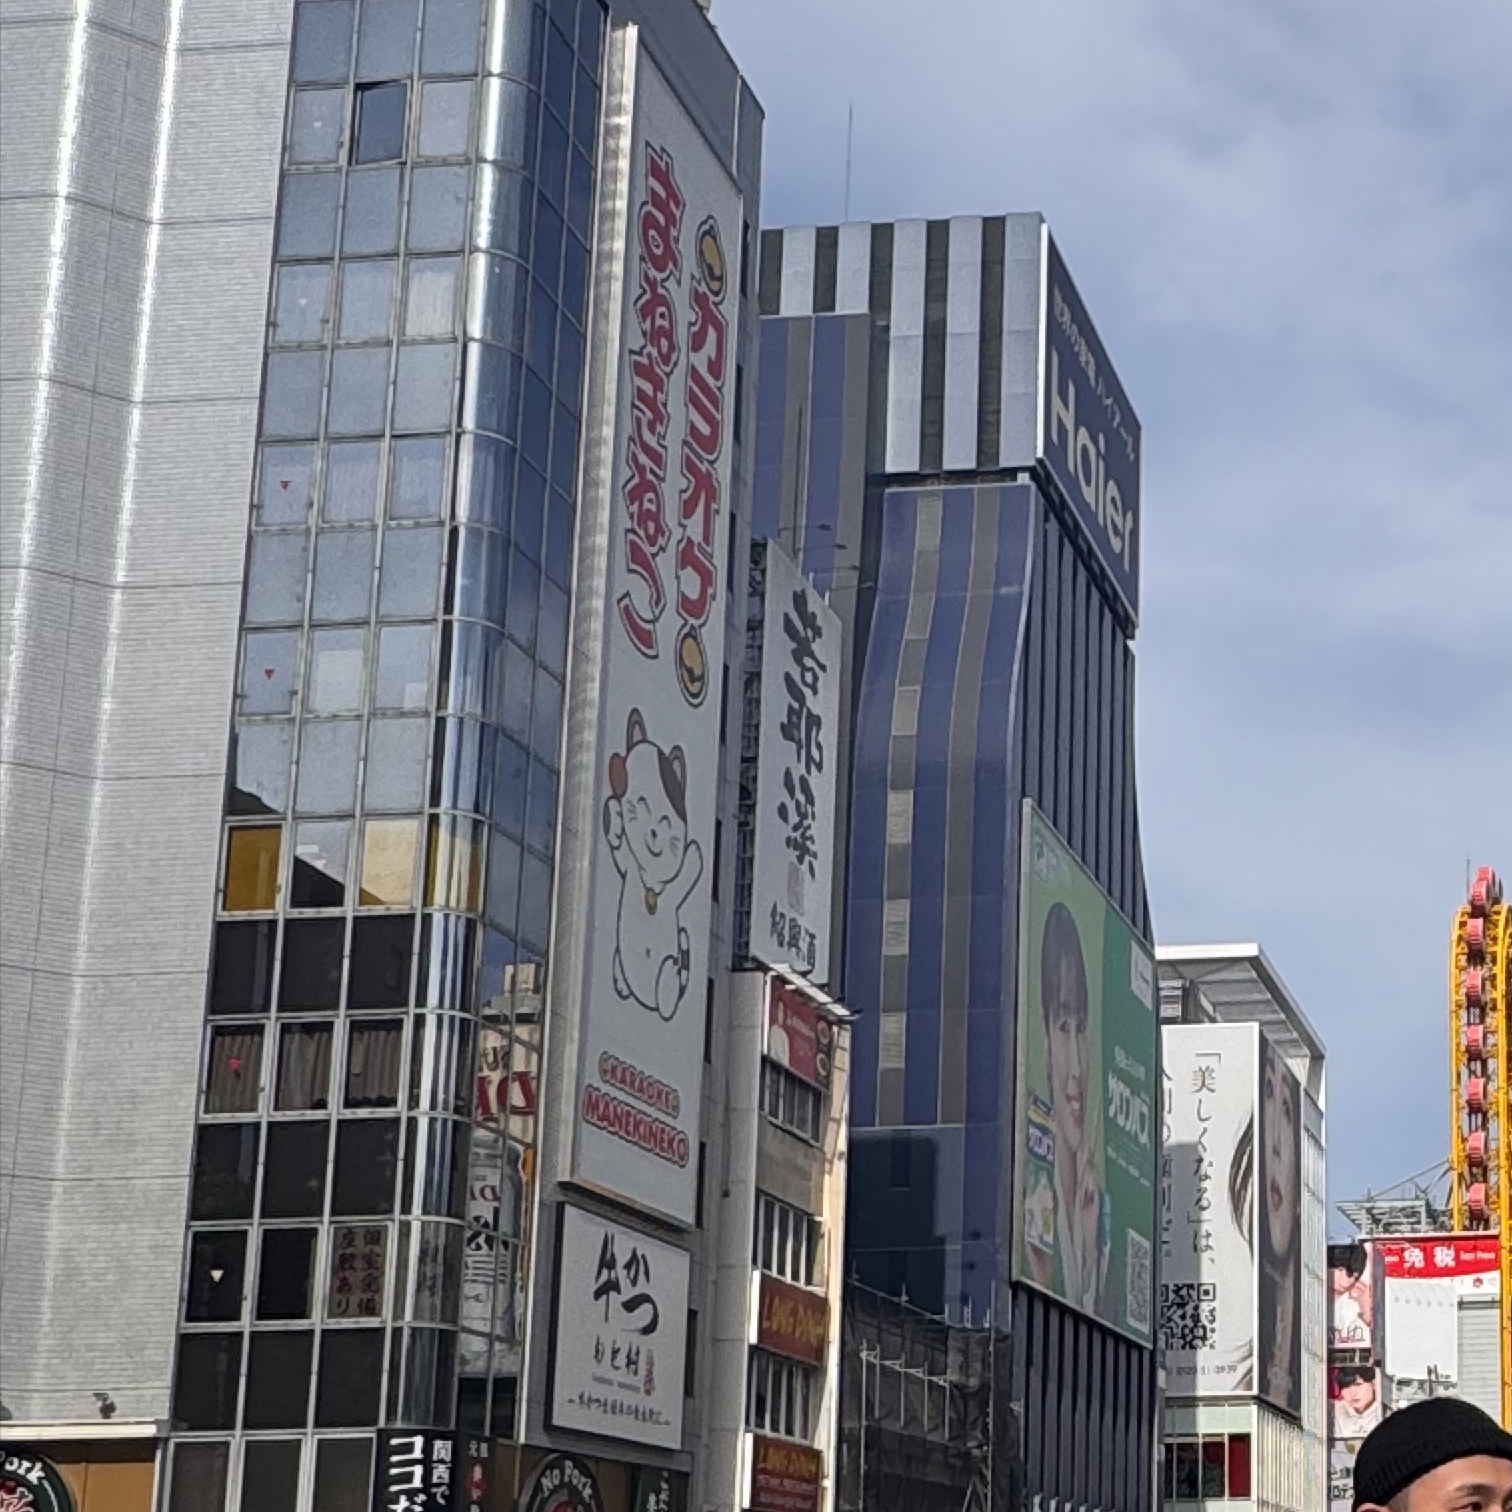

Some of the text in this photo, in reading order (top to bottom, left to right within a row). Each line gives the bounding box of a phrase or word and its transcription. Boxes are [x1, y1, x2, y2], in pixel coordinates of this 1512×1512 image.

[617, 139, 686, 660] まねきねこ
[677, 272, 728, 628] カラオケ
[1051, 347, 1134, 574] Haier
[607, 1058, 672, 1113] KARAOKE
[583, 1087, 688, 1167] MANEKINEKO
[593, 1230, 660, 1335] 牛かつ
[1402, 1246, 1456, 1268] 免税
[0, 1453, 46, 1485] ork
[431, 1438, 453, 1506] 関西で
[541, 1459, 593, 1503] No Pork
